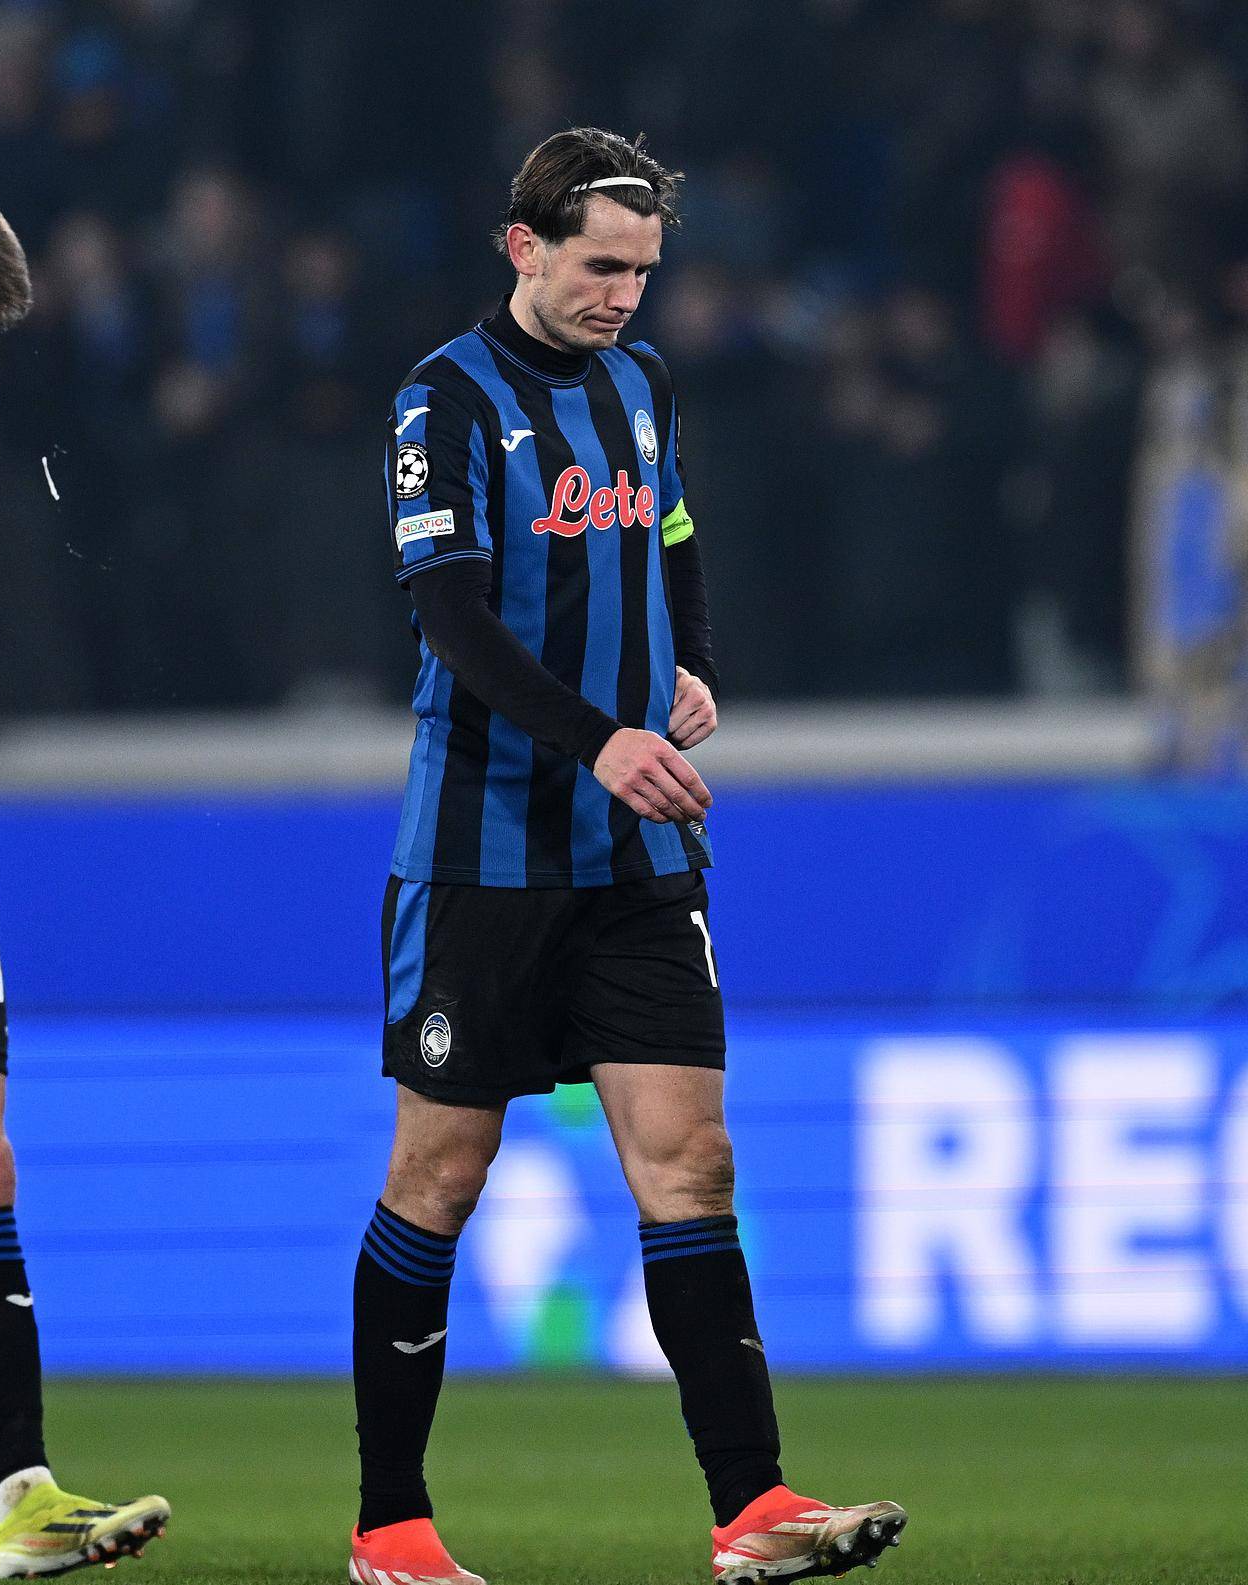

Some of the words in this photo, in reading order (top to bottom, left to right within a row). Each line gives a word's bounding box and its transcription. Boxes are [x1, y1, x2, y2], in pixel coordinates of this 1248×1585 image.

[402, 517, 452, 534] NDATION
[531, 465, 655, 537] Lete
[852, 1032, 1248, 1351] RE
